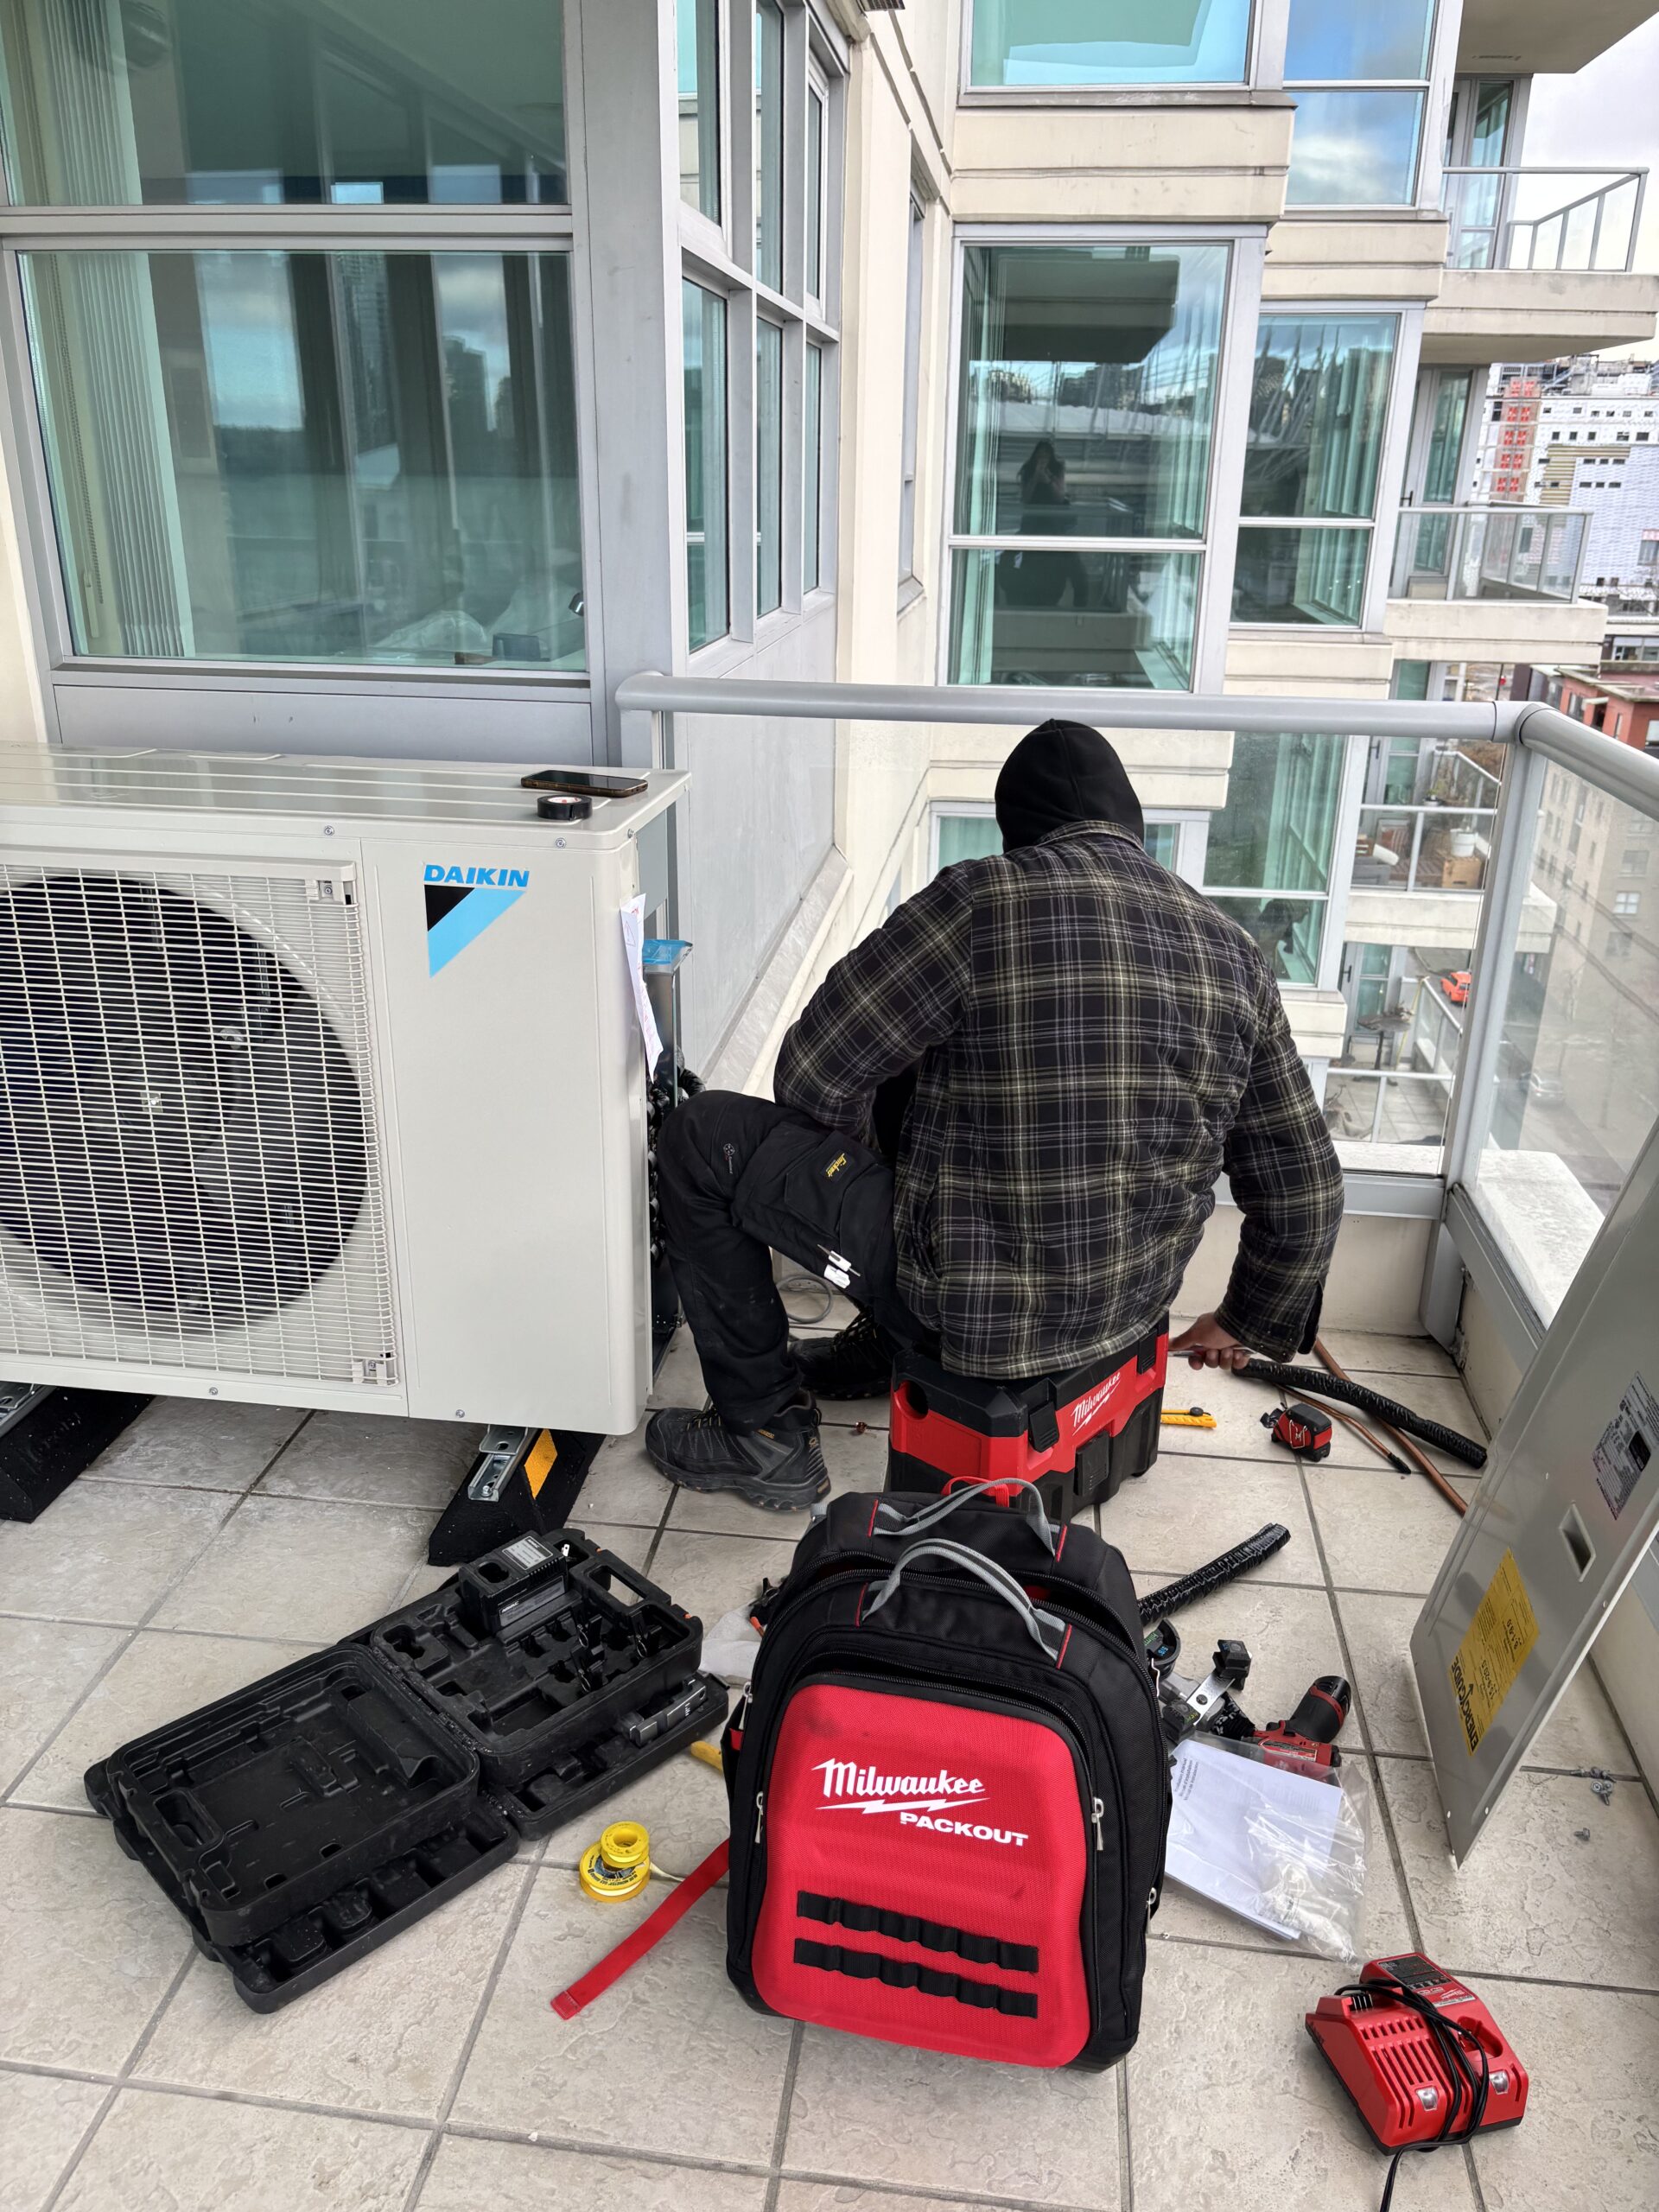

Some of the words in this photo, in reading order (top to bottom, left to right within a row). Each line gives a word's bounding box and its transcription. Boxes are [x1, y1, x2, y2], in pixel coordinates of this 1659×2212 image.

[423, 864, 530, 887] DAIKIN
[1071, 1371, 1121, 1427] Milwaukee
[811, 1758, 986, 1797] Milwaukee
[899, 1811, 1029, 1847] PACKOUT
